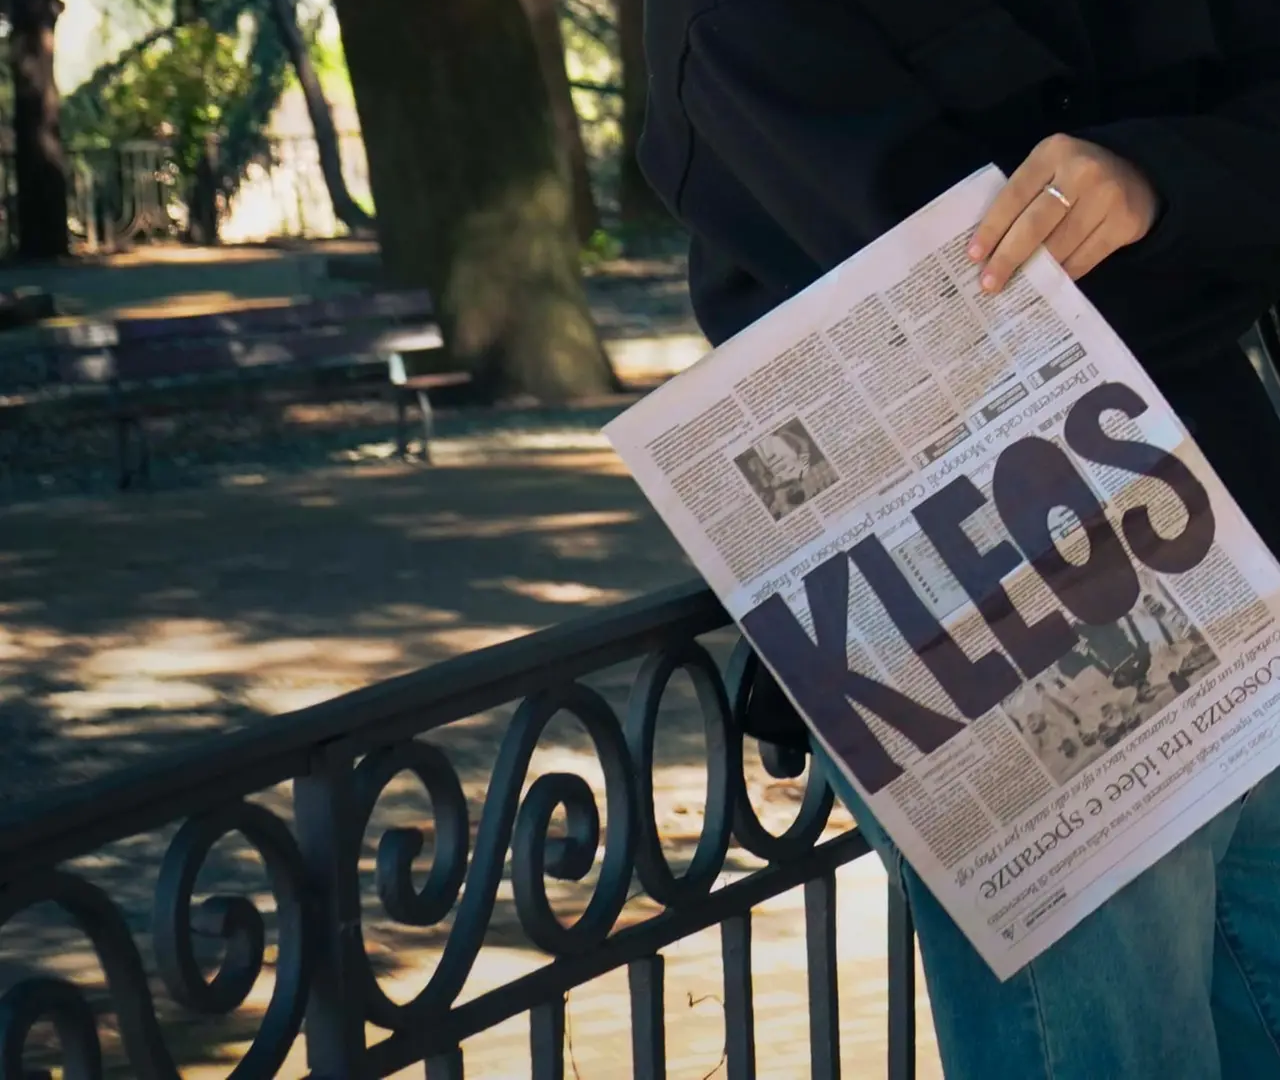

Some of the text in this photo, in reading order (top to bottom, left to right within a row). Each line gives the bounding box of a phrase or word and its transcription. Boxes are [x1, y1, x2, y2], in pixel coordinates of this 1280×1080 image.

[1021, 368, 1089, 421] Benevento
[983, 433, 995, 446] a
[992, 413, 1027, 443] cade
[923, 437, 988, 489] Monopoli
[746, 480, 928, 609] Crotone pericoloso ma fragile
[742, 380, 1217, 795] KLEOS
[1216, 665, 1234, 682] un
[1155, 726, 1194, 763] tra
[1101, 753, 1162, 809] idee
[1081, 793, 1105, 818] e
[968, 844, 1000, 873] Play
[971, 802, 1088, 902] speranze
